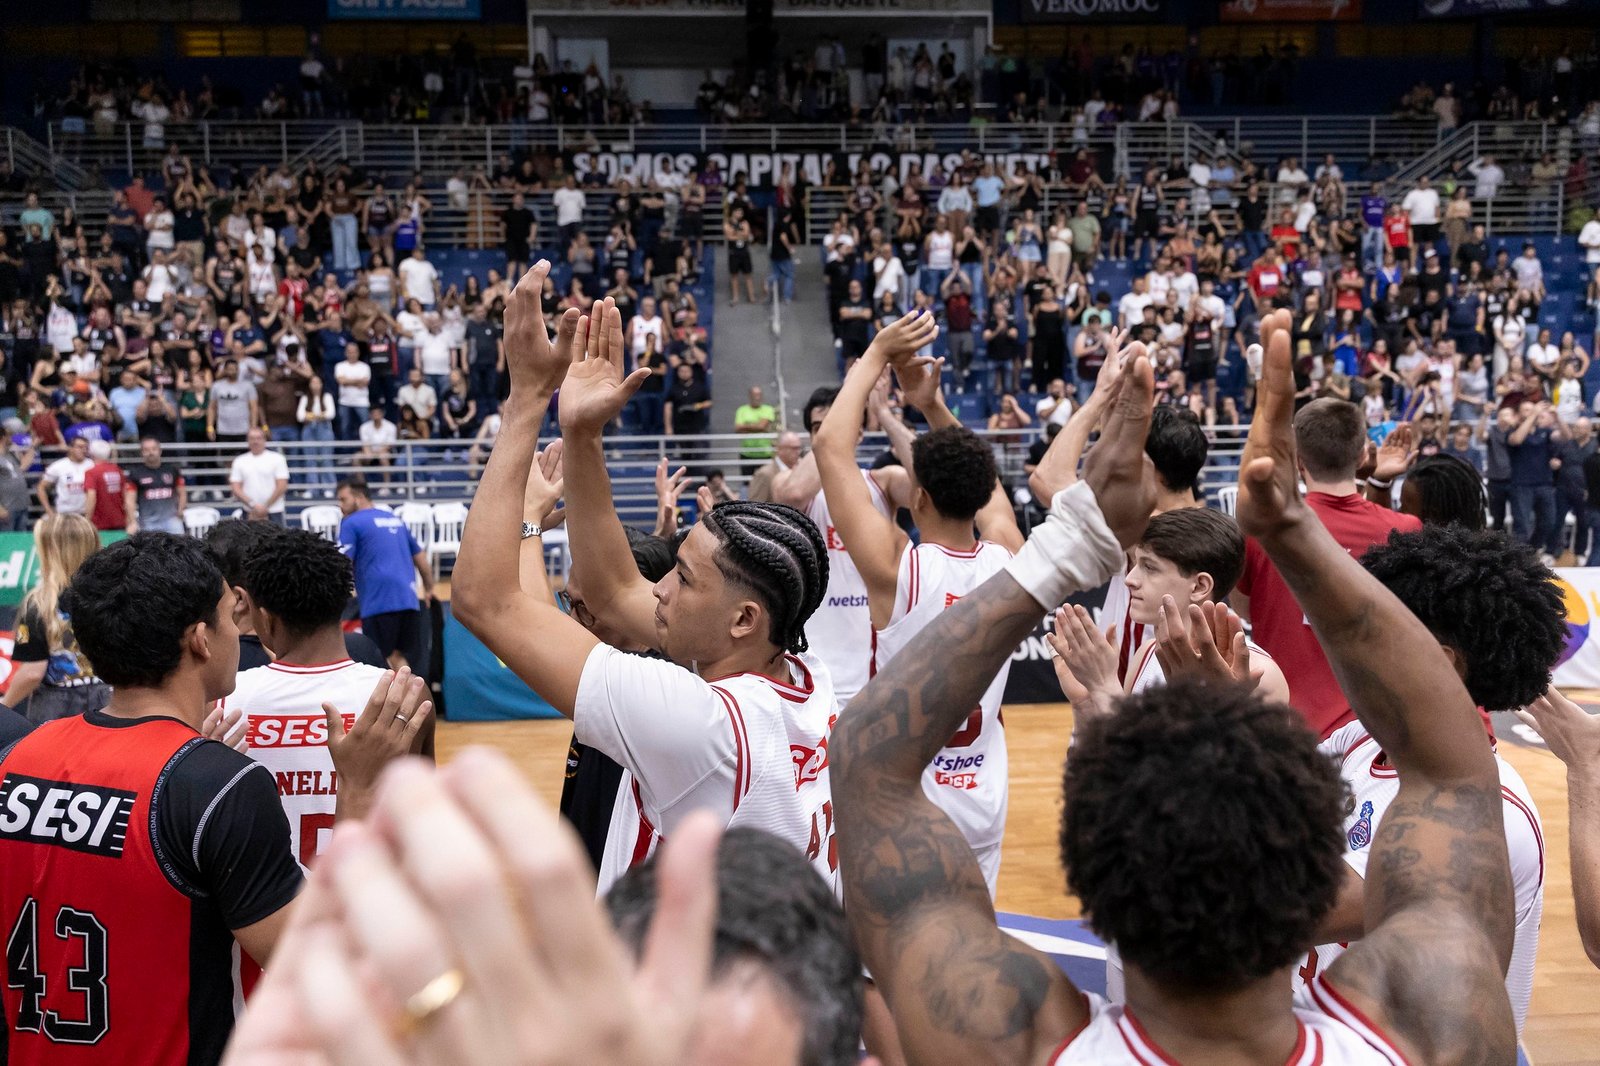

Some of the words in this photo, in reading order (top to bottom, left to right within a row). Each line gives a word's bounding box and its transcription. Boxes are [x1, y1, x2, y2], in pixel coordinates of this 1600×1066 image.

[254, 718, 328, 746] SES
[152, 775, 166, 804] AMIZADE
[164, 745, 191, 772] DISCIPLINA
[934, 754, 984, 771] tshoe
[0, 782, 121, 847] SESI
[6, 897, 109, 1044] 43
